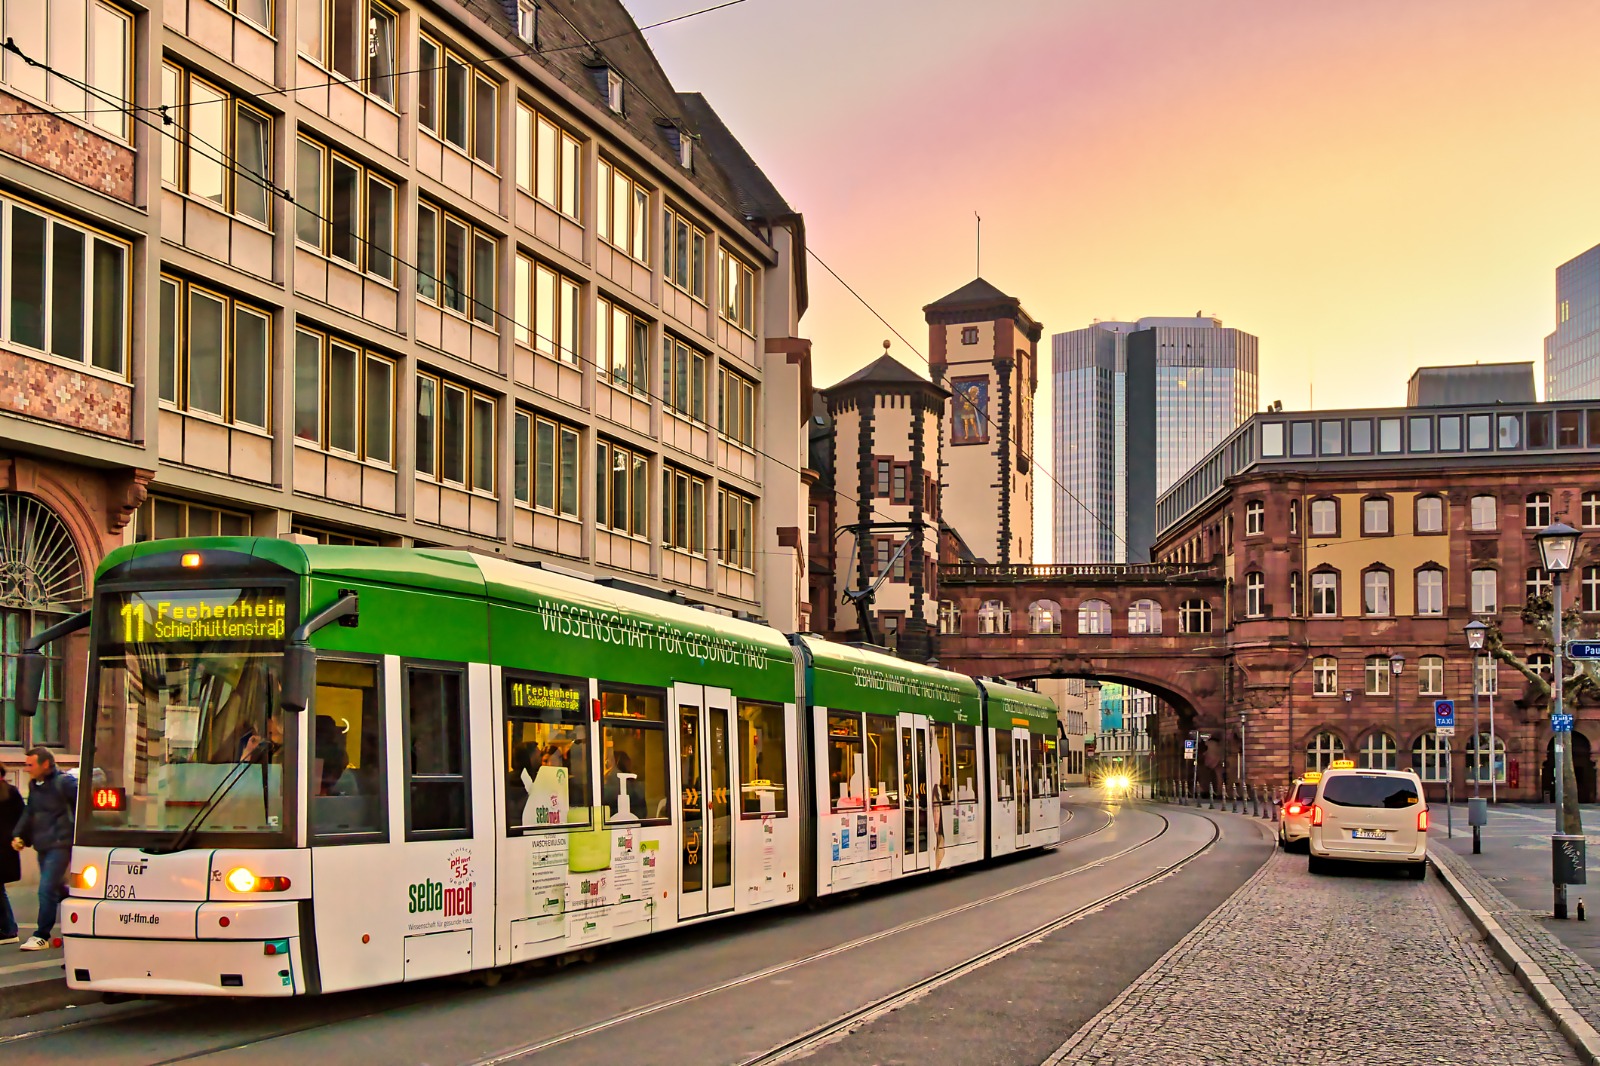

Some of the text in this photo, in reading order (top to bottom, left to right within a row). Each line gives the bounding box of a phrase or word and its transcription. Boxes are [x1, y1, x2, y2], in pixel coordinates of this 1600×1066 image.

[158, 599, 286, 620] Fechenheim
[120, 603, 145, 642] 11
[537, 598, 768, 671] WISSENSCHAFT FÜR GESUNDE HAUT
[513, 683, 524, 706] 11
[526, 684, 580, 700] Fechenheim
[97, 789, 117, 807] 04
[127, 863, 148, 875] VGF
[450, 856, 461, 870] pH
[455, 863, 468, 879] 5,5
[106, 885, 136, 899] 236 A
[408, 877, 473, 917] sebamed
[119, 913, 160, 925] vgf-ffm.de
